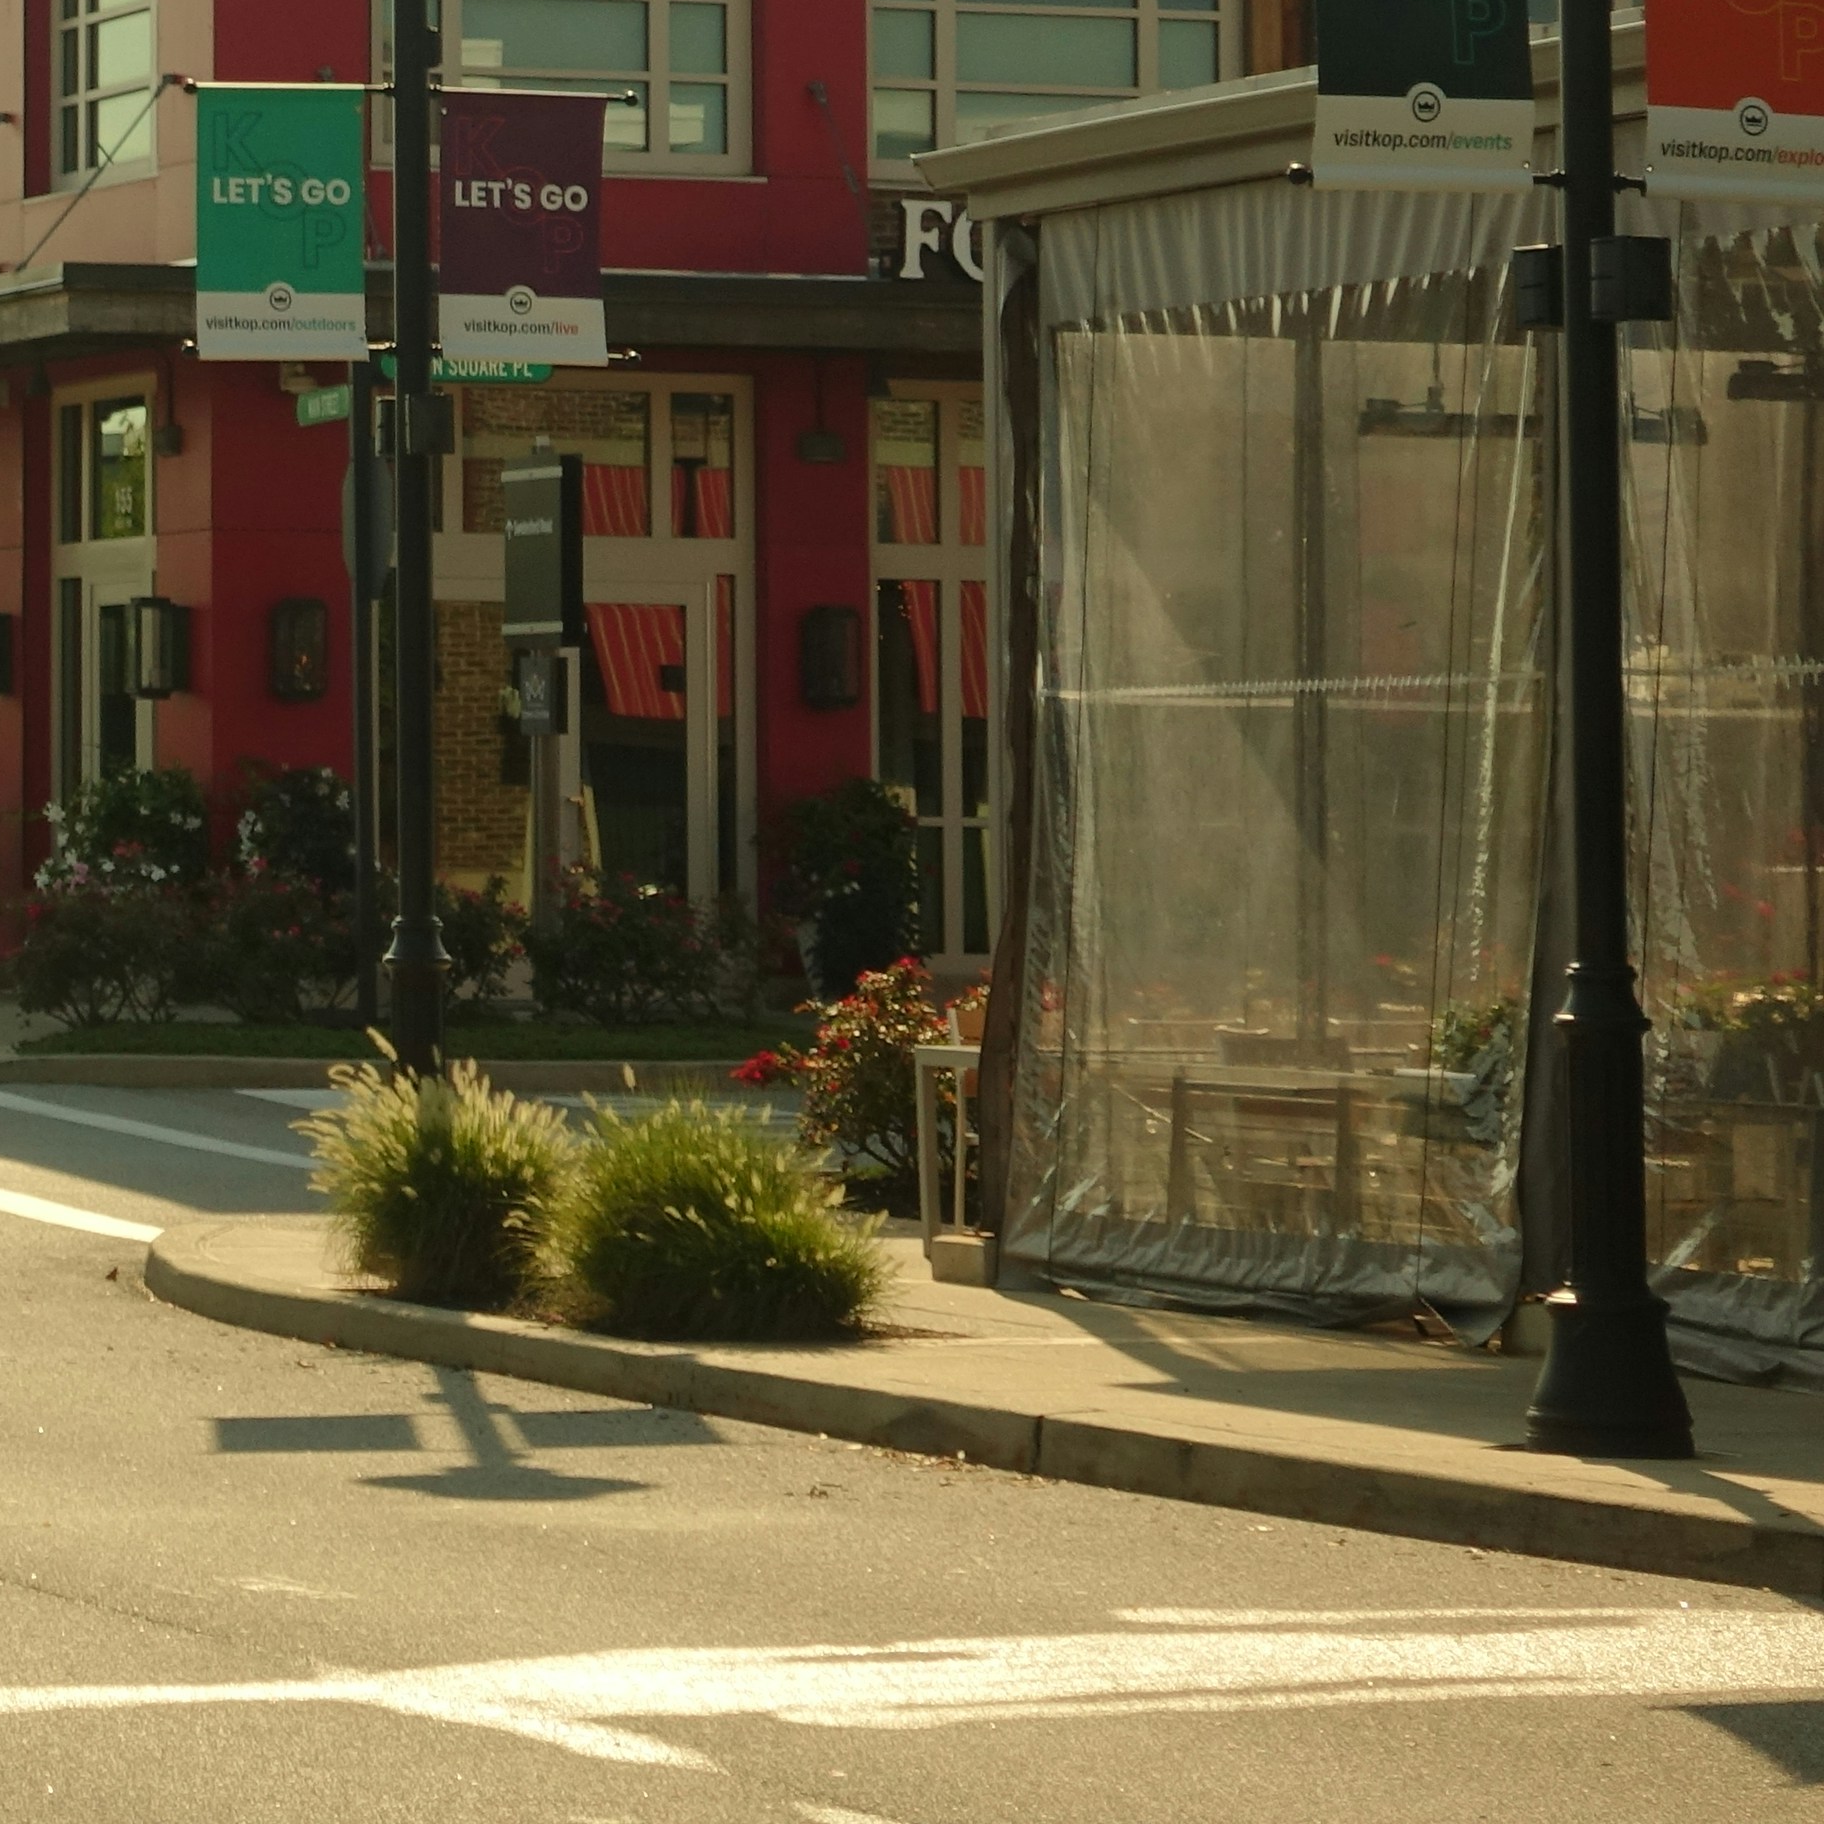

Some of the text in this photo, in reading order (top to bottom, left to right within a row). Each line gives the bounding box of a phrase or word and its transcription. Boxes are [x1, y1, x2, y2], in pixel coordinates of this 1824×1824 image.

[1334, 129, 1512, 152] visitkop.com/events
[213, 173, 350, 205] LET'S GO
[455, 178, 588, 212] LET'S GO
[206, 315, 356, 333] visitkop.com/outdoors
[464, 319, 580, 336] visitkop.com/live
[449, 359, 507, 377] SQUARE
